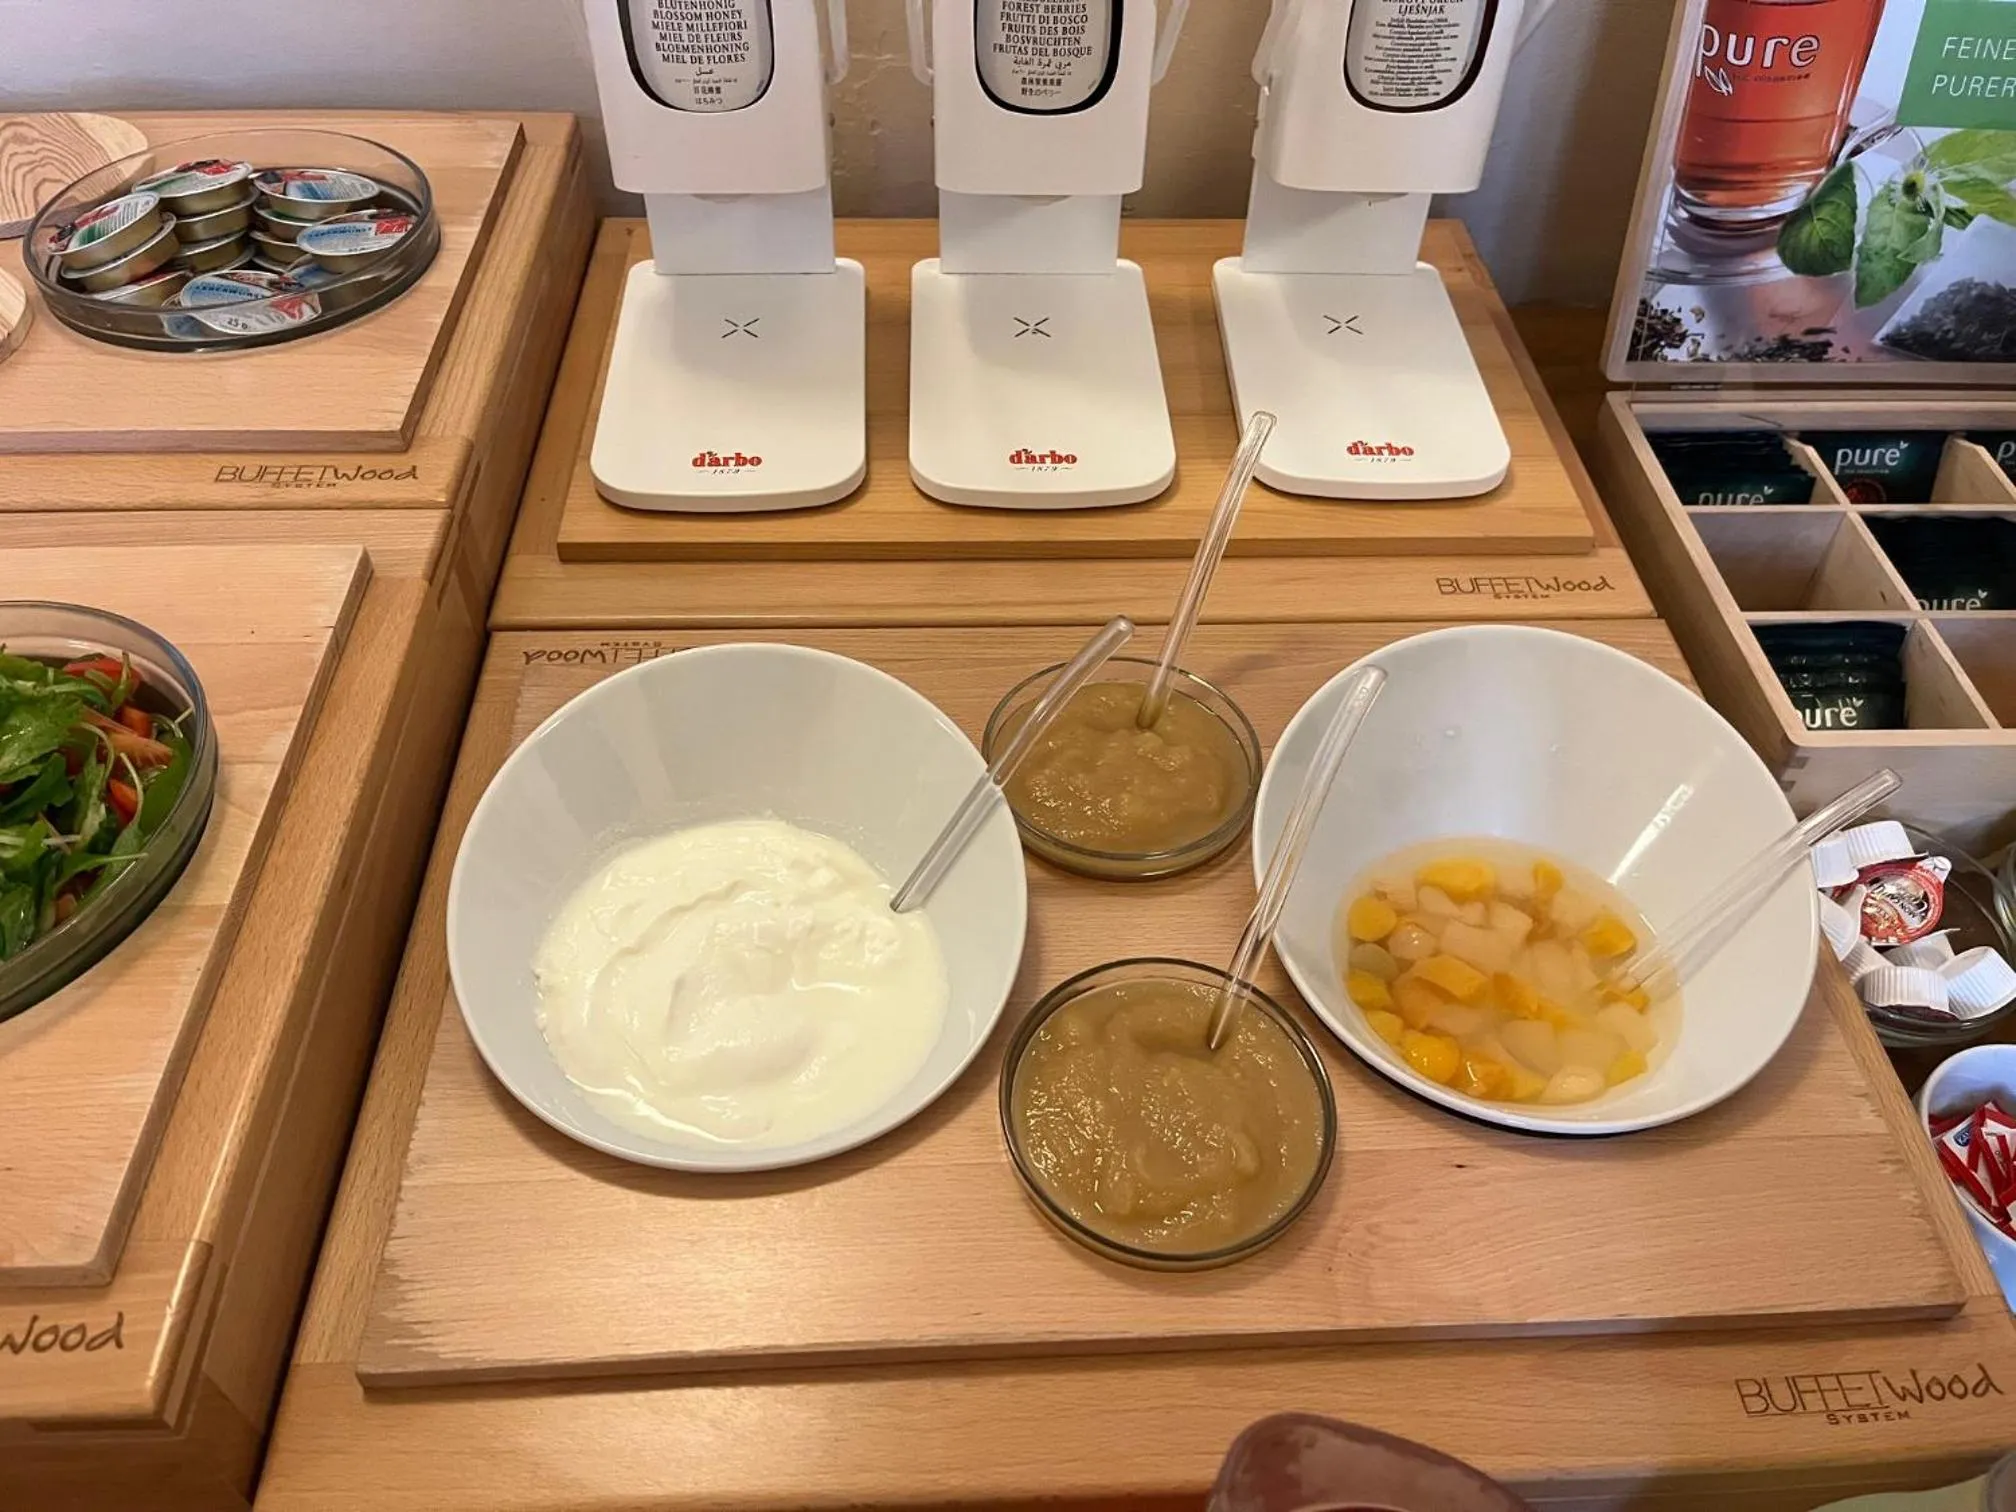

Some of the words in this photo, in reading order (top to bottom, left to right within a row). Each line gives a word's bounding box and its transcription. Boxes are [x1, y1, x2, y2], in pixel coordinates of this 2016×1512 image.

[1002, 1, 1041, 13] FOREST
[1043, 4, 1087, 14] BERRIES
[1398, 5, 1446, 18] LJEŠNJAK
[653, 9, 702, 20] BLOSSOM
[705, 9, 743, 20] HONEY
[1000, 12, 1036, 22] FRUTTI
[1038, 15, 1050, 25] DI
[1052, 14, 1089, 25] BOSCO
[651, 20, 684, 31] MIELE
[686, 20, 748, 32] MILLEFIORI
[1001, 23, 1037, 35] FRUITS
[1039, 26, 1058, 36] DES
[1061, 26, 1086, 36] BOIS
[659, 32, 685, 43] MIEL
[687, 33, 702, 43] DE
[704, 32, 743, 43] FLEURS
[1005, 34, 1081, 46] BOSVRUCHTEN
[655, 42, 750, 53] BLOEMENHONING
[992, 43, 1029, 55] FRUTAS
[1031, 47, 1050, 57] DEL
[1052, 46, 1093, 58] BOSQUE
[1695, 24, 1820, 77] pure
[1941, 36, 2016, 60] FEINE
[661, 53, 687, 64] MIEL
[690, 55, 704, 64] DE
[706, 54, 746, 64] FLORES
[1931, 74, 2016, 98] PURER
[1834, 448, 1900, 475] pure
[1825, 1410, 1912, 1426] SYSTEM
